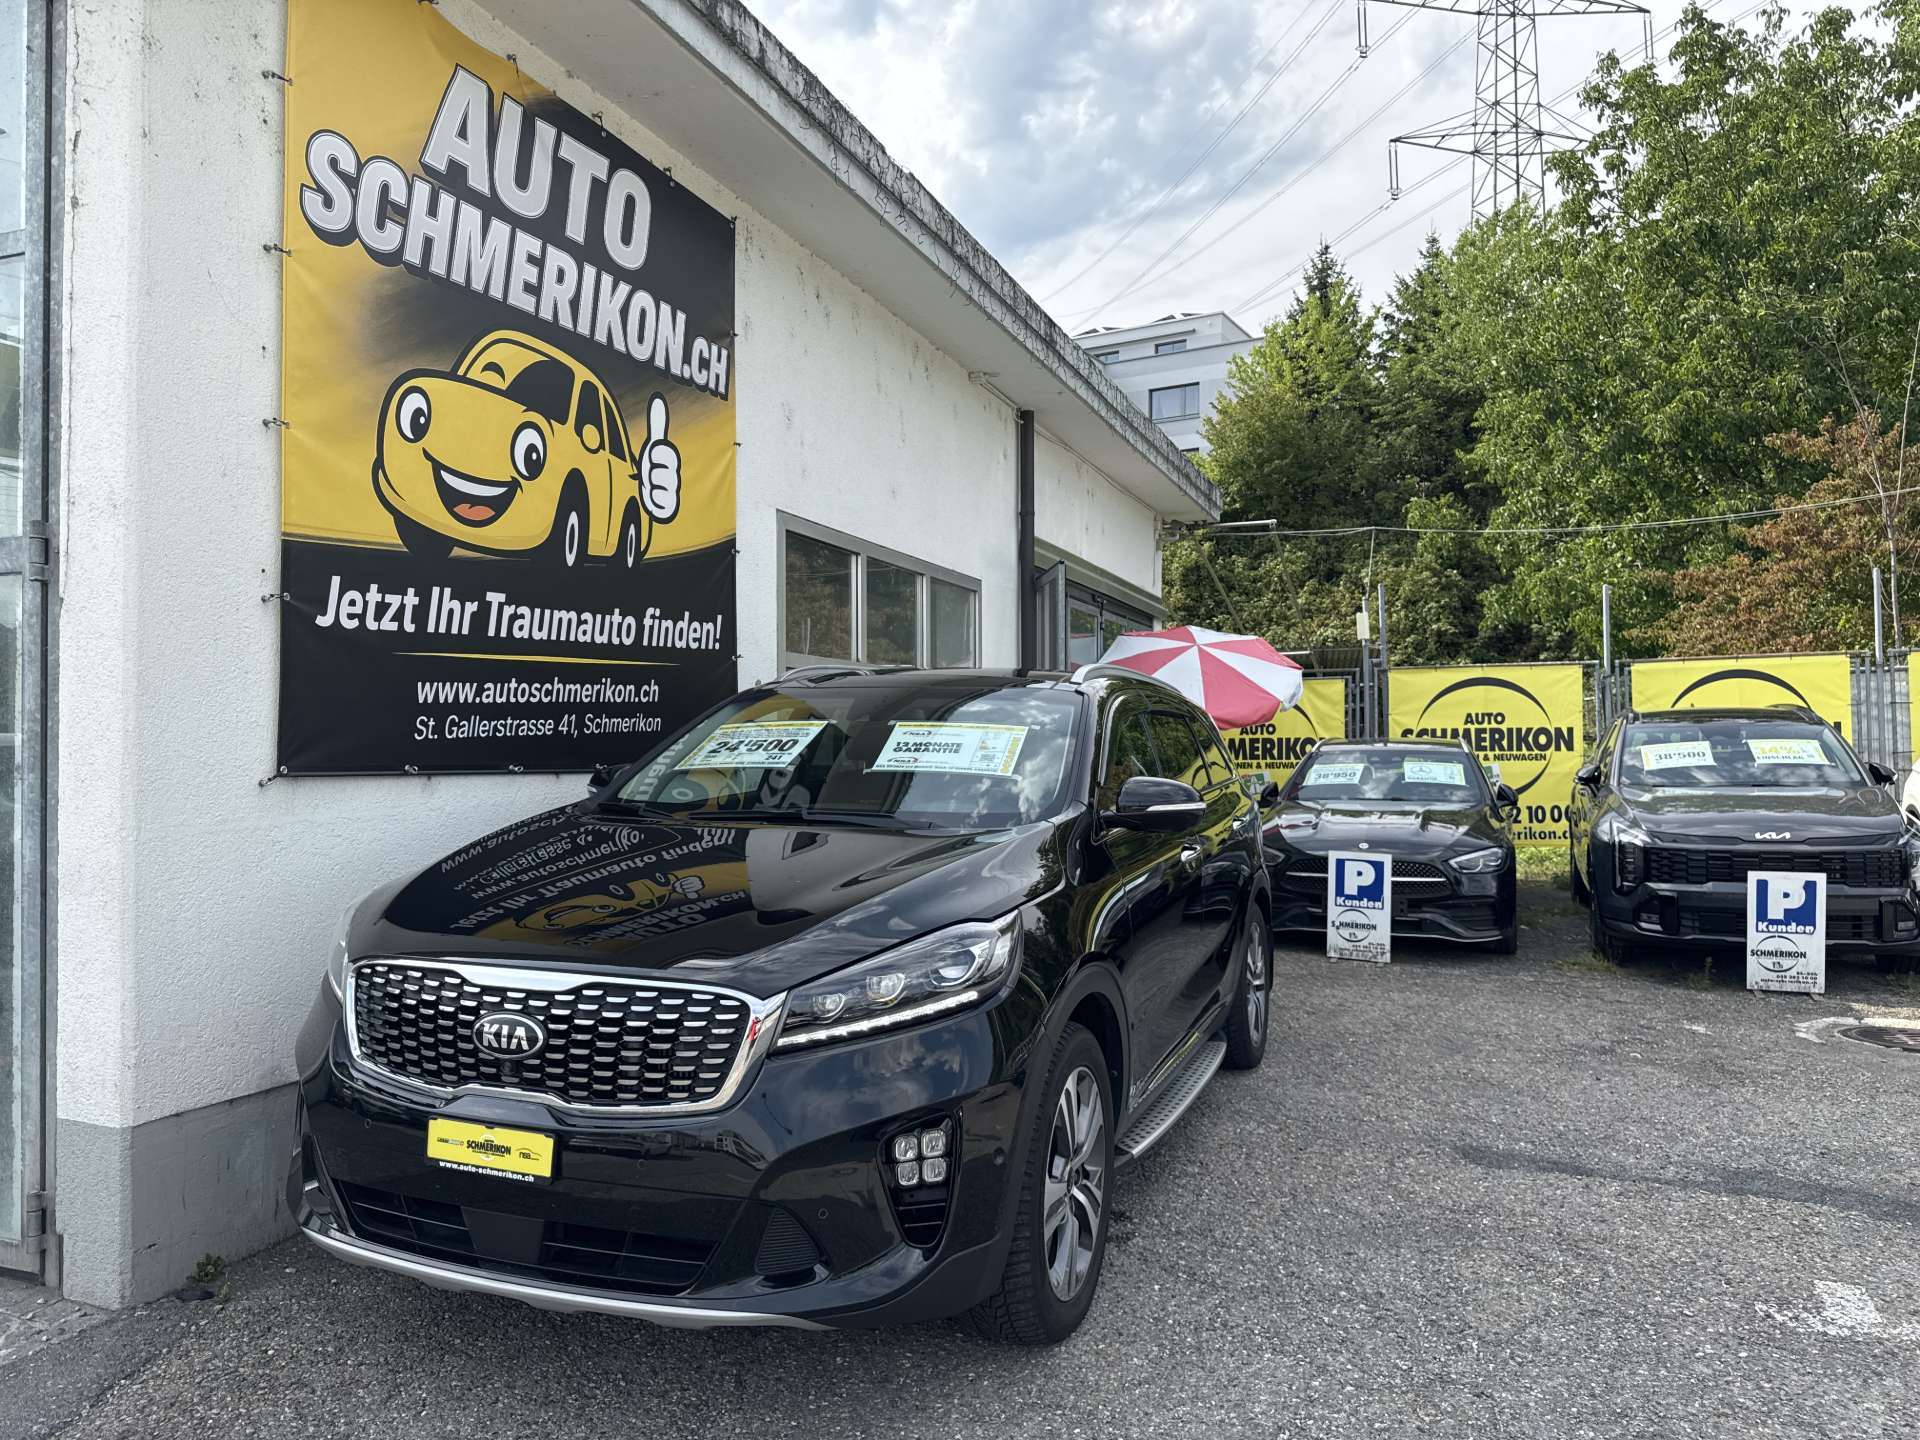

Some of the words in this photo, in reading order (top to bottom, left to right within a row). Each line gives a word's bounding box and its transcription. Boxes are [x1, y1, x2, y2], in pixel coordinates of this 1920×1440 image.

[421, 63, 652, 270] AUTO
[302, 131, 729, 397] SCHMERIKON.CH
[315, 576, 418, 631] Jetzt
[427, 587, 478, 635] Ihr
[485, 591, 636, 646] Traumauto
[643, 608, 722, 650] finden!
[417, 677, 659, 704] www.autoschmerikon.ch
[414, 716, 438, 740] St.
[445, 715, 554, 739] Gallerstrasse
[558, 716, 578, 738] 41,
[584, 714, 661, 734] Schmerikon
[1240, 723, 1276, 735] AUTO
[1464, 712, 1506, 725] AUTO
[707, 739, 799, 754] 24'500
[1228, 737, 1325, 760] MERIKO
[1483, 753, 1490, 761] &
[1494, 753, 1547, 761] NEUWAGEN
[1344, 860, 1375, 895] P
[1336, 896, 1382, 909] Kunden
[1767, 879, 1806, 920] P
[1331, 920, 1377, 931] SHMERIKON
[1757, 921, 1814, 934] Kunden
[1750, 949, 1807, 959] SCHMERIKON
[482, 1022, 529, 1050] KIA
[467, 1139, 511, 1155] SCHMERIKON
[439, 1161, 535, 1182] www.auto-schmerikon.ch
